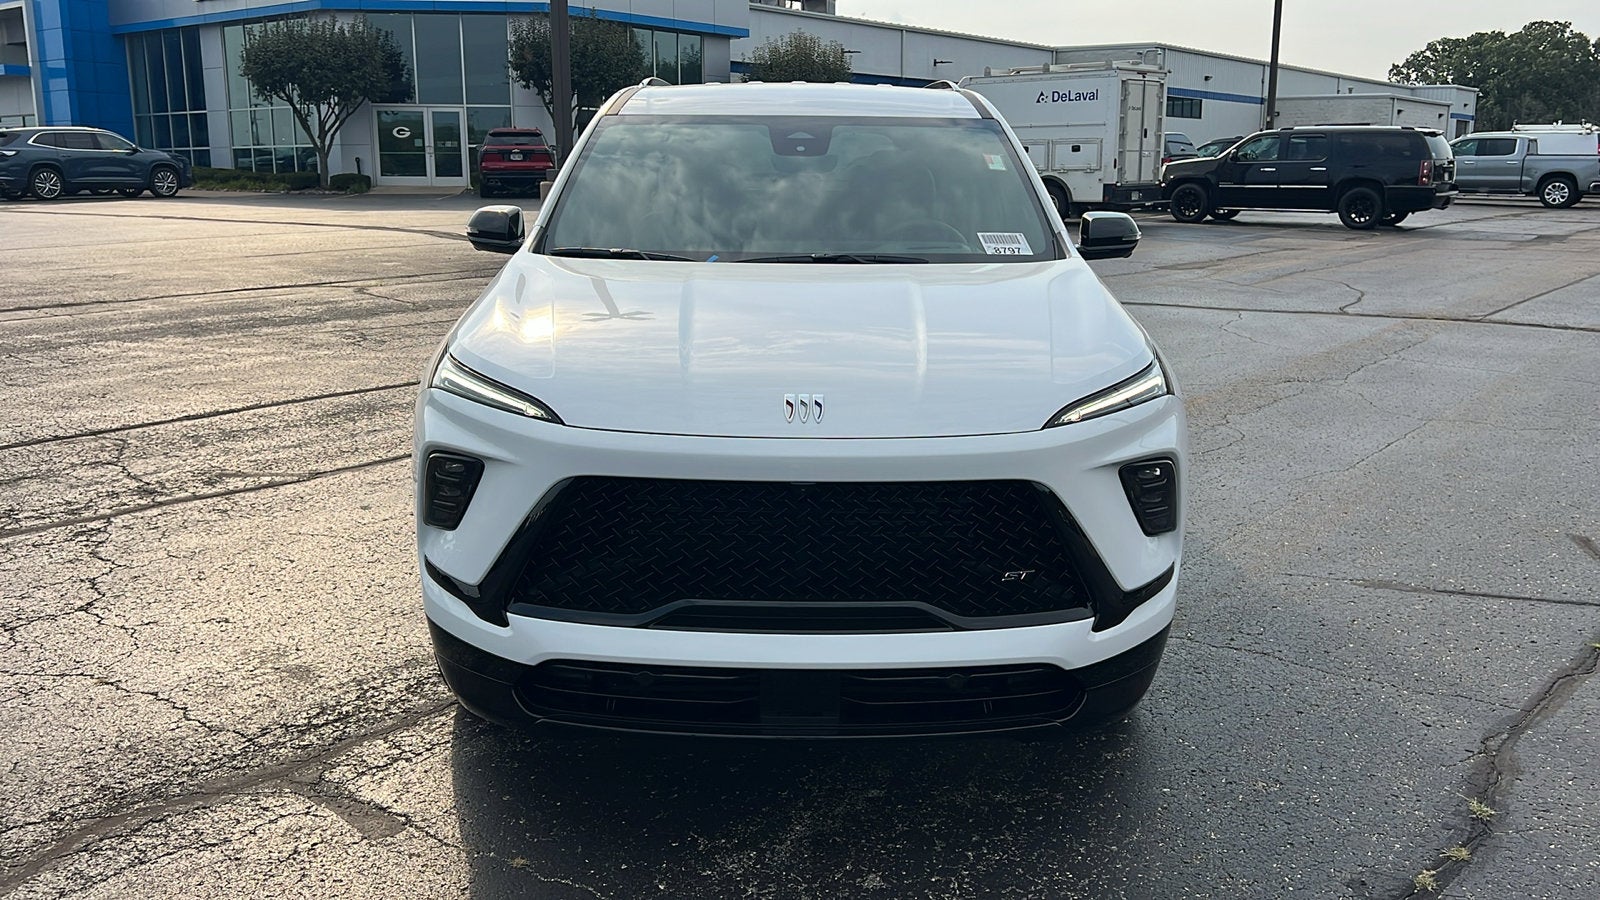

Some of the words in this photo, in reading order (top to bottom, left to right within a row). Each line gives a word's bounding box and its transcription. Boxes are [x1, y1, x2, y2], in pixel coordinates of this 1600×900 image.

[1051, 88, 1099, 103] DeLaval
[392, 126, 411, 139] G
[993, 246, 1021, 255] 8797
[1001, 569, 1036, 582] ST
